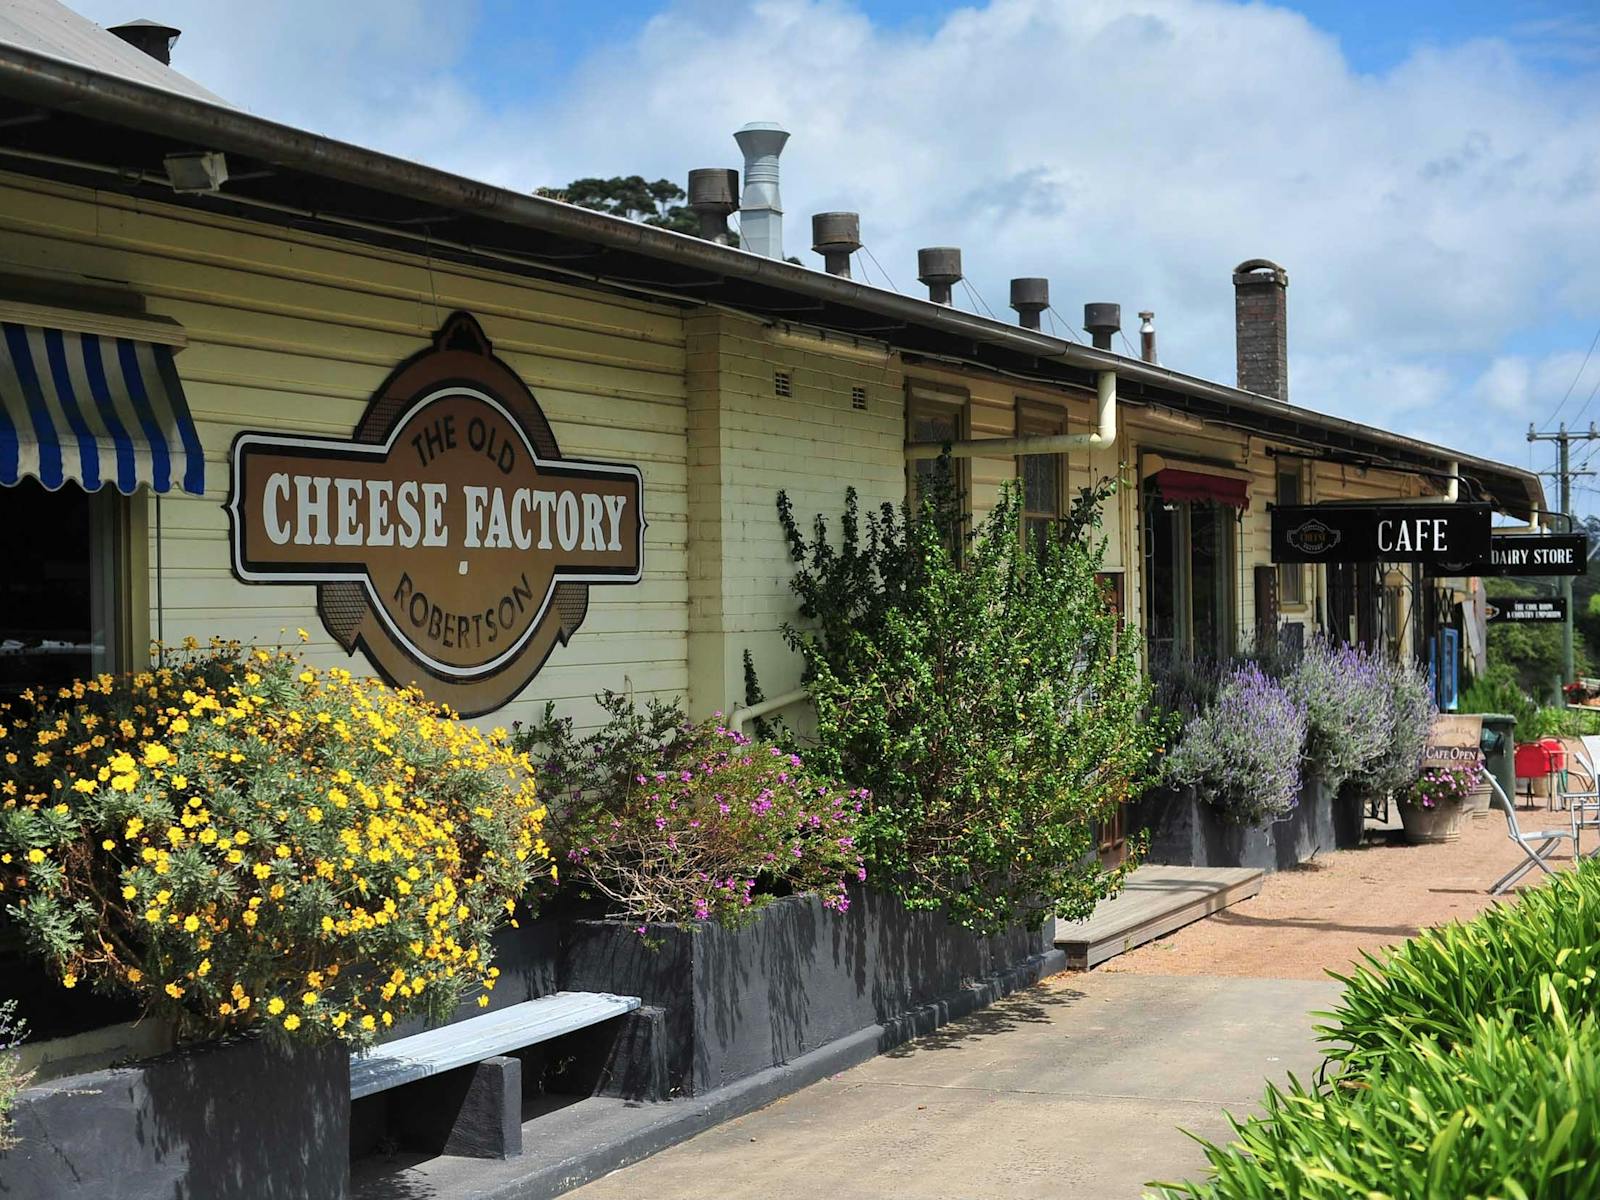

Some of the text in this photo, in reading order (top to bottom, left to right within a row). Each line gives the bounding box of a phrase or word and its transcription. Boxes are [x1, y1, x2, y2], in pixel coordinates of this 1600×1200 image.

[410, 415, 515, 475] THE OLD
[262, 472, 627, 552] CHEESE FACTORY
[1377, 519, 1448, 552] CAFE
[1490, 548, 1574, 565] DAIRY STORE
[393, 571, 534, 649] ROBERTSON
